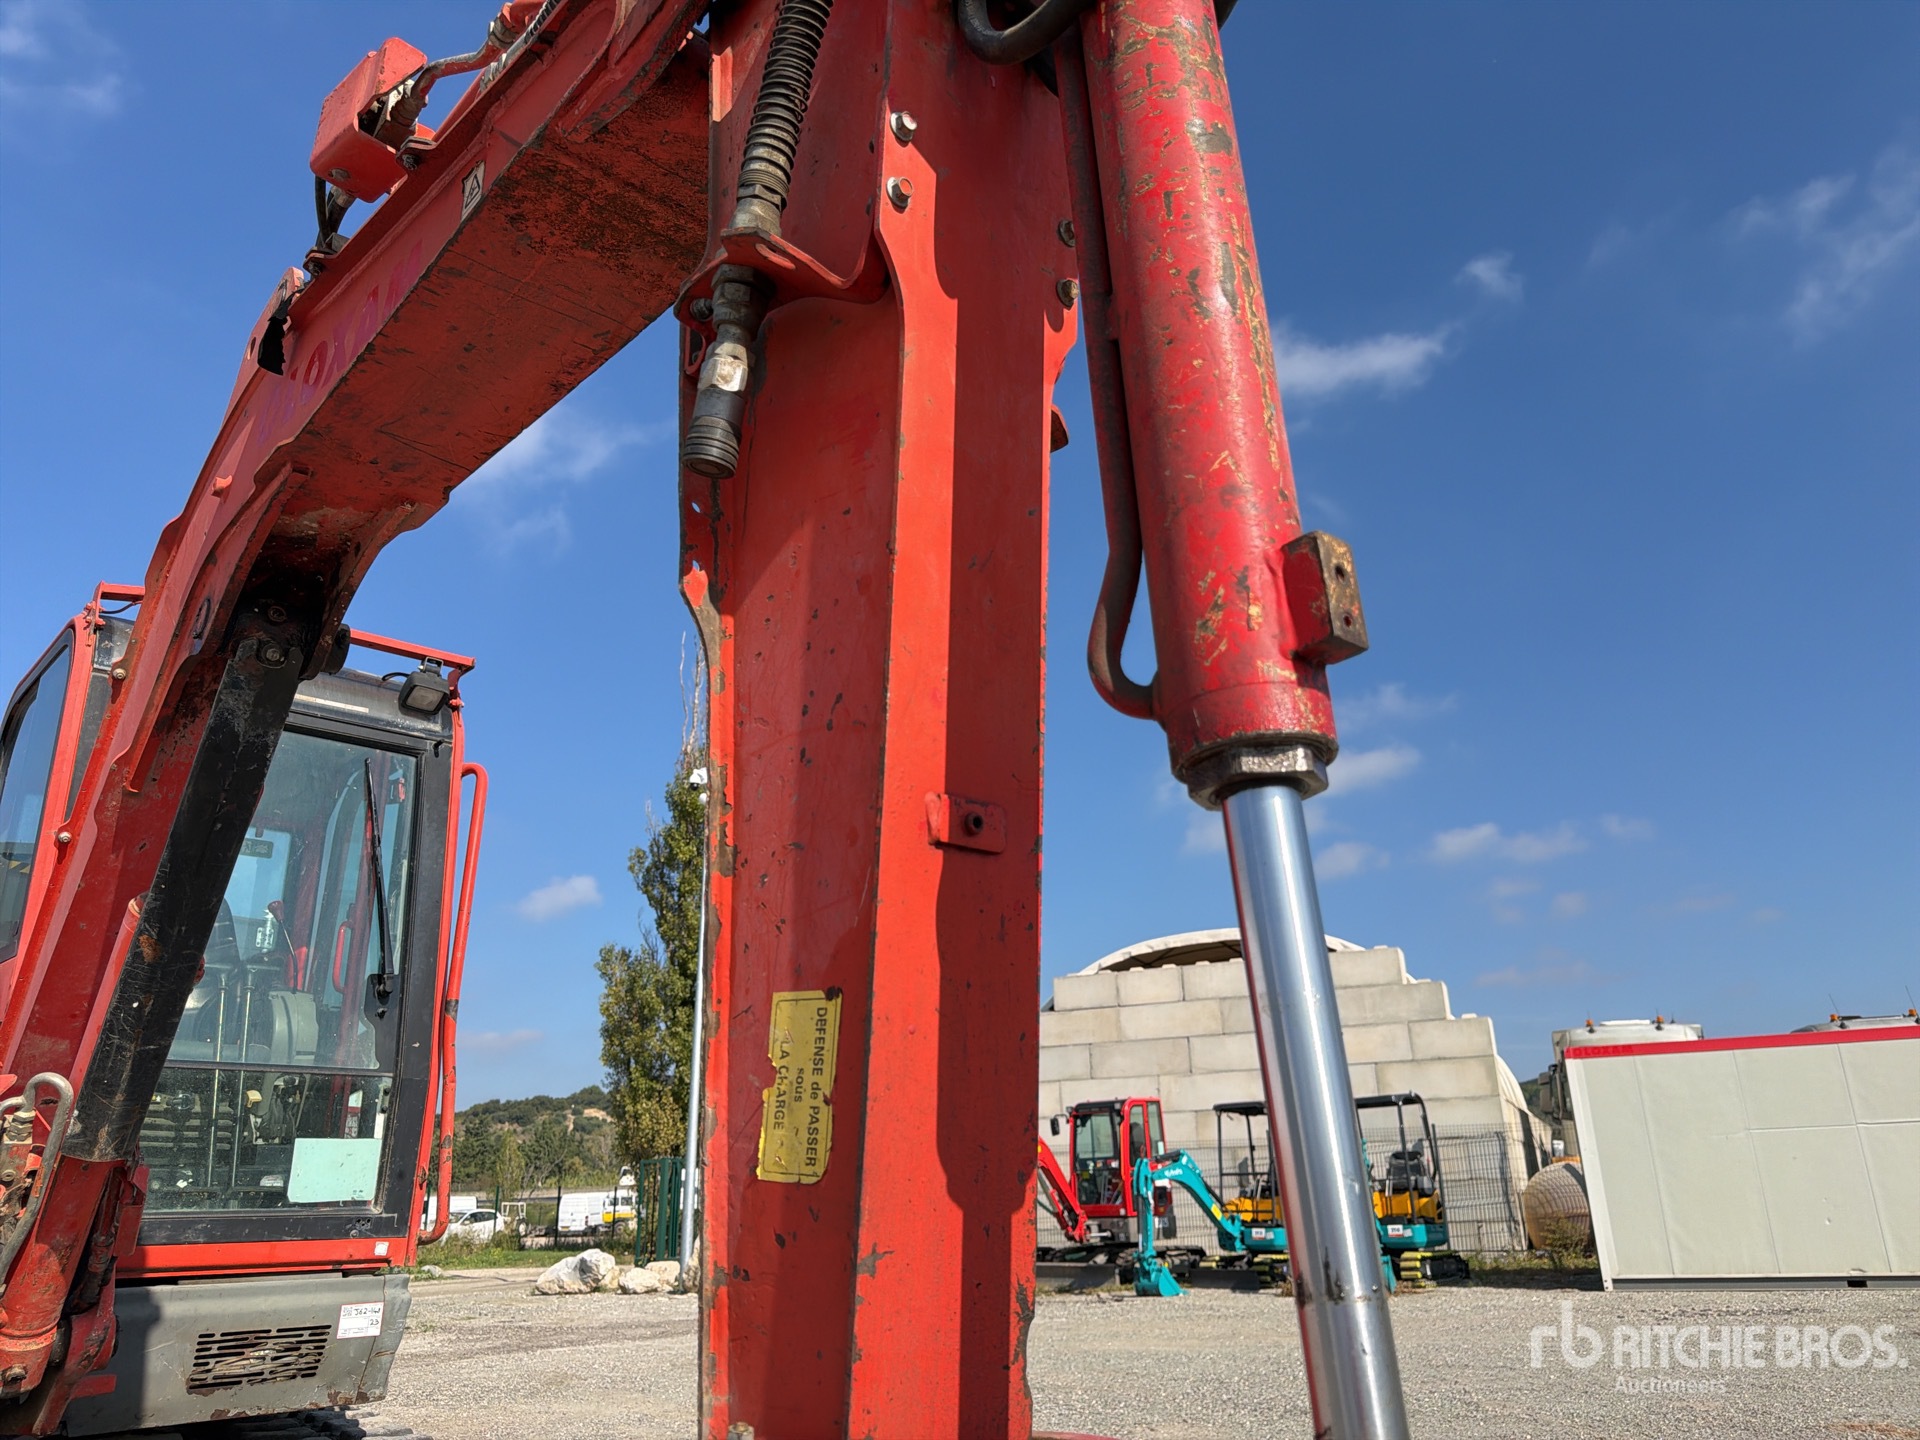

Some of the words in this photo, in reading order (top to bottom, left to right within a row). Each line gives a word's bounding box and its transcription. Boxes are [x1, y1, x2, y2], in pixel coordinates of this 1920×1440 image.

[779, 1040, 790, 1060] LA
[812, 1007, 827, 1076] DEFENSE
[773, 1065, 790, 1131] CHARGE
[793, 1067, 805, 1103] sous
[809, 1081, 823, 1100] de
[805, 1106, 820, 1167] PASSER
